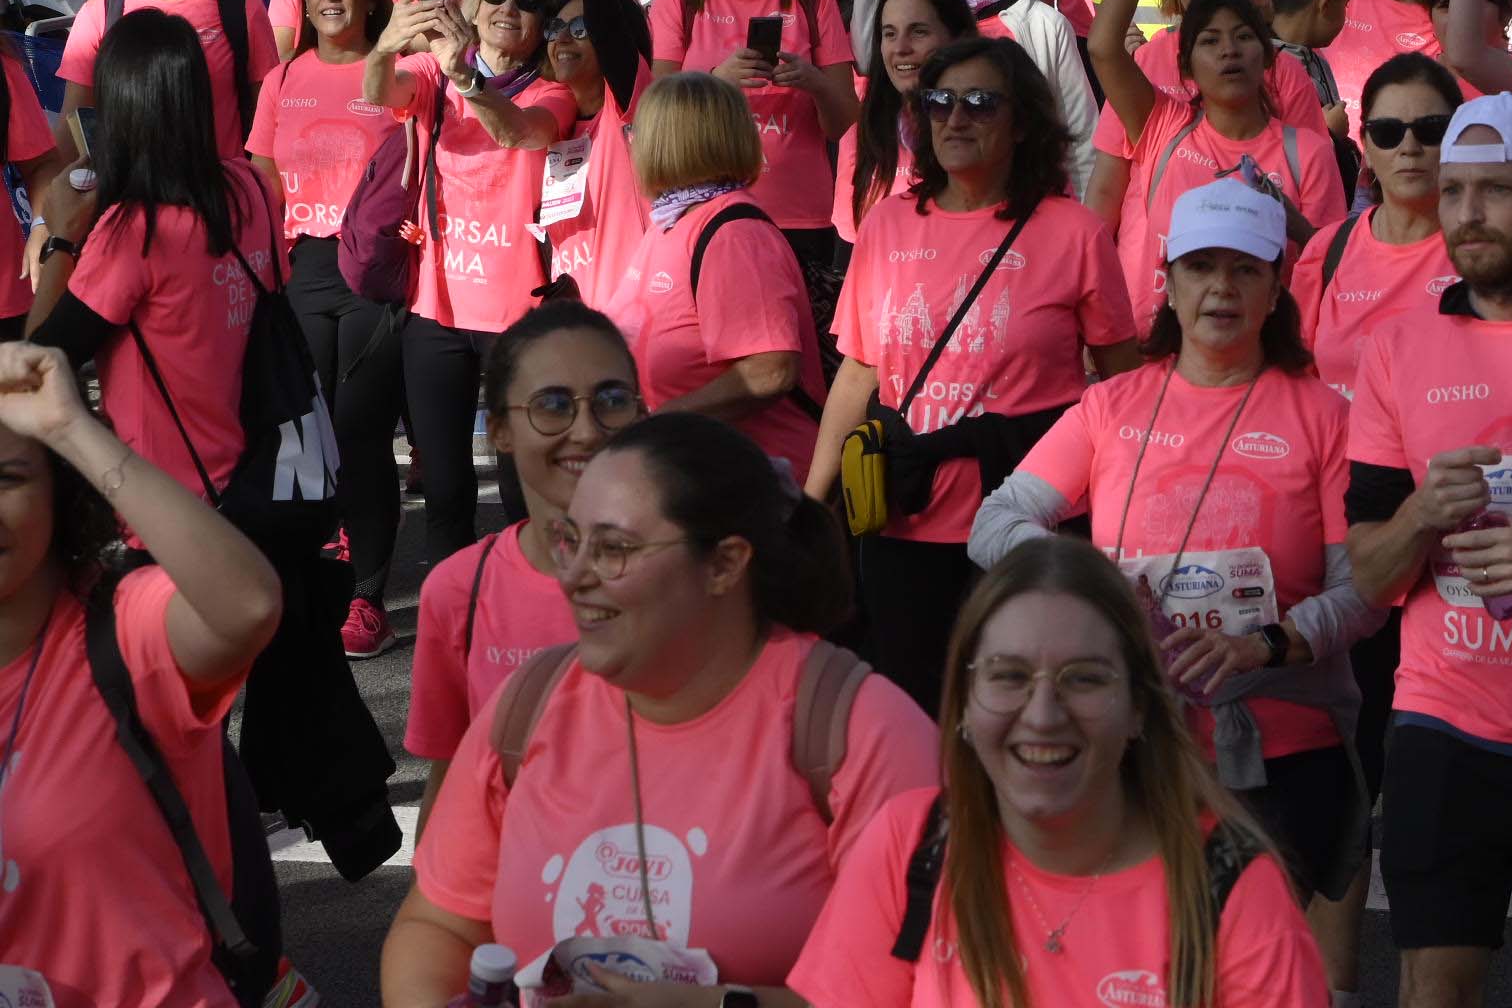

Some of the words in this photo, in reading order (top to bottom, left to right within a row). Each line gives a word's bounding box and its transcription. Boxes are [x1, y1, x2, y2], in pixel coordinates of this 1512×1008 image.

[280, 97, 318, 109] OYSHO
[1176, 146, 1218, 170] OYSHO
[888, 248, 937, 263] OYSHO
[1426, 382, 1490, 405] OYSHO
[1118, 424, 1186, 449] OYSHO
[1236, 439, 1286, 456] ASTURIANA
[1229, 568, 1264, 579] SUMA
[1165, 578, 1220, 593] ASTURIANA
